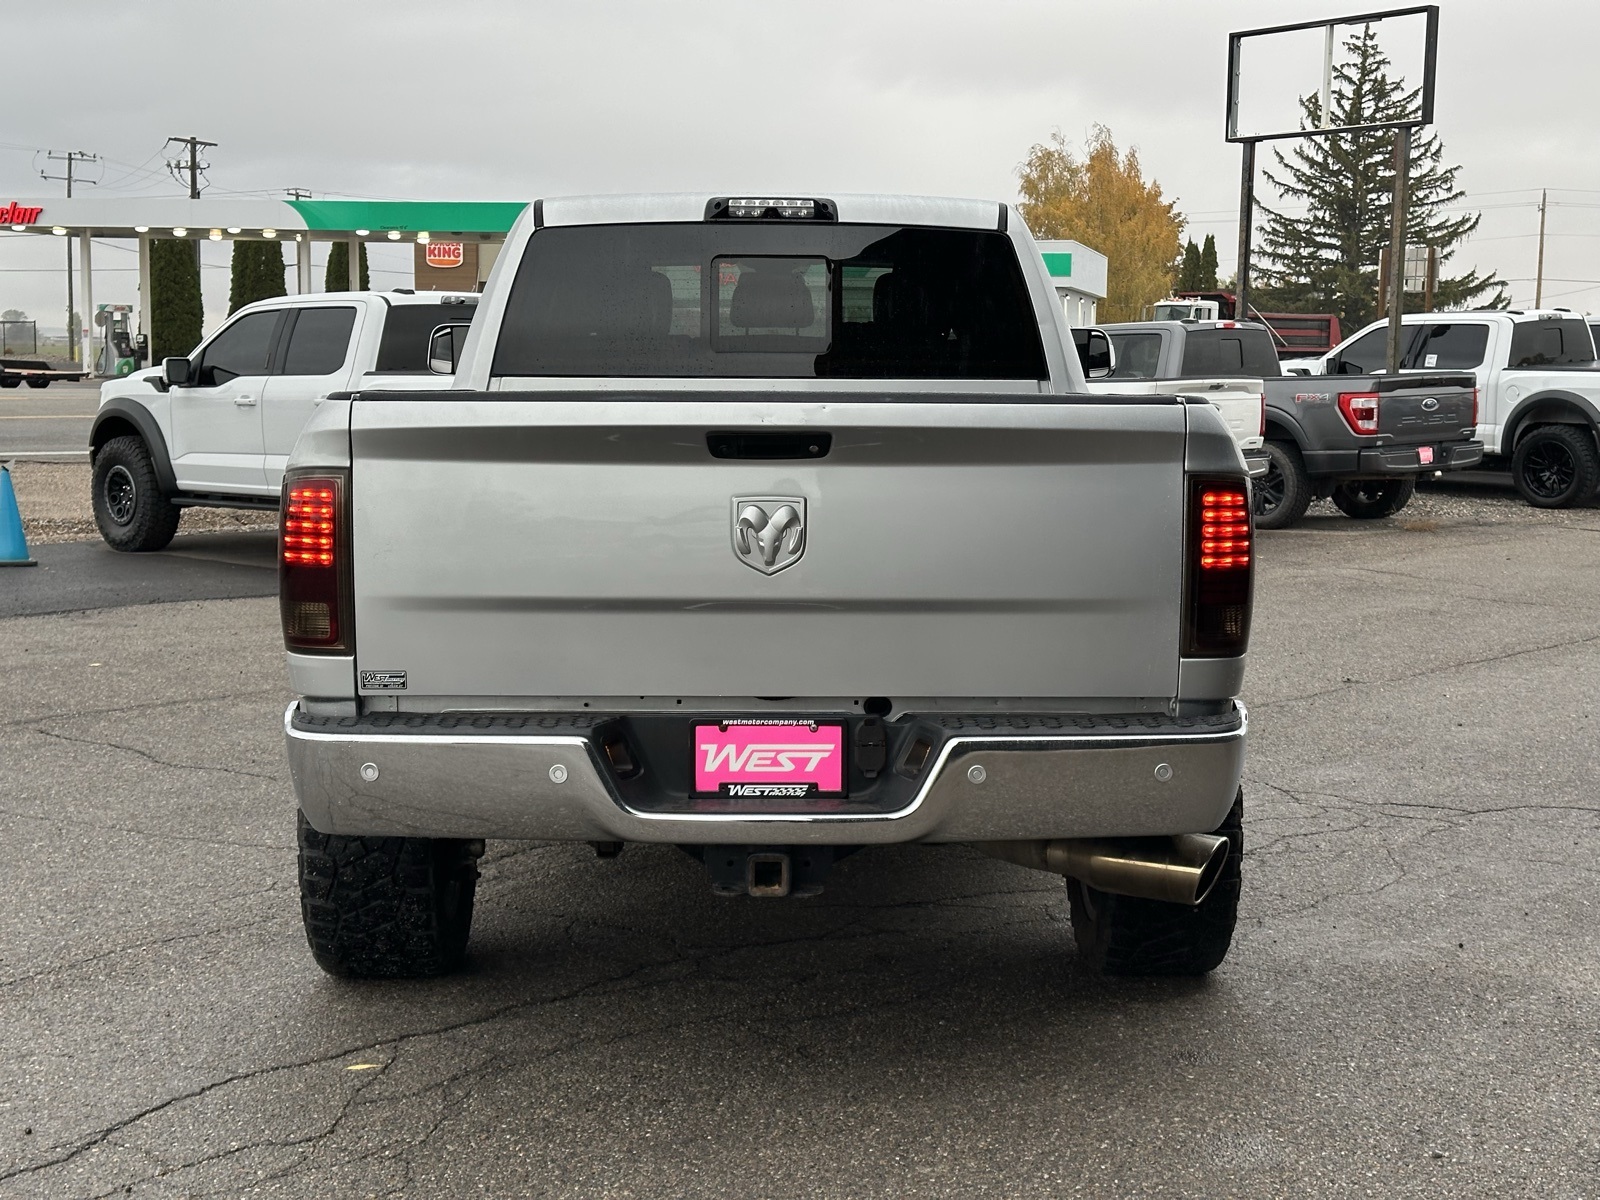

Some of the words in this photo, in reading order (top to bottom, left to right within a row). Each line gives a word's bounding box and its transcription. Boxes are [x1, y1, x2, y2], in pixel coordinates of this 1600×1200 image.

[428, 247, 461, 258] KING
[1295, 393, 1329, 403] FX4
[700, 743, 836, 772] WEST
